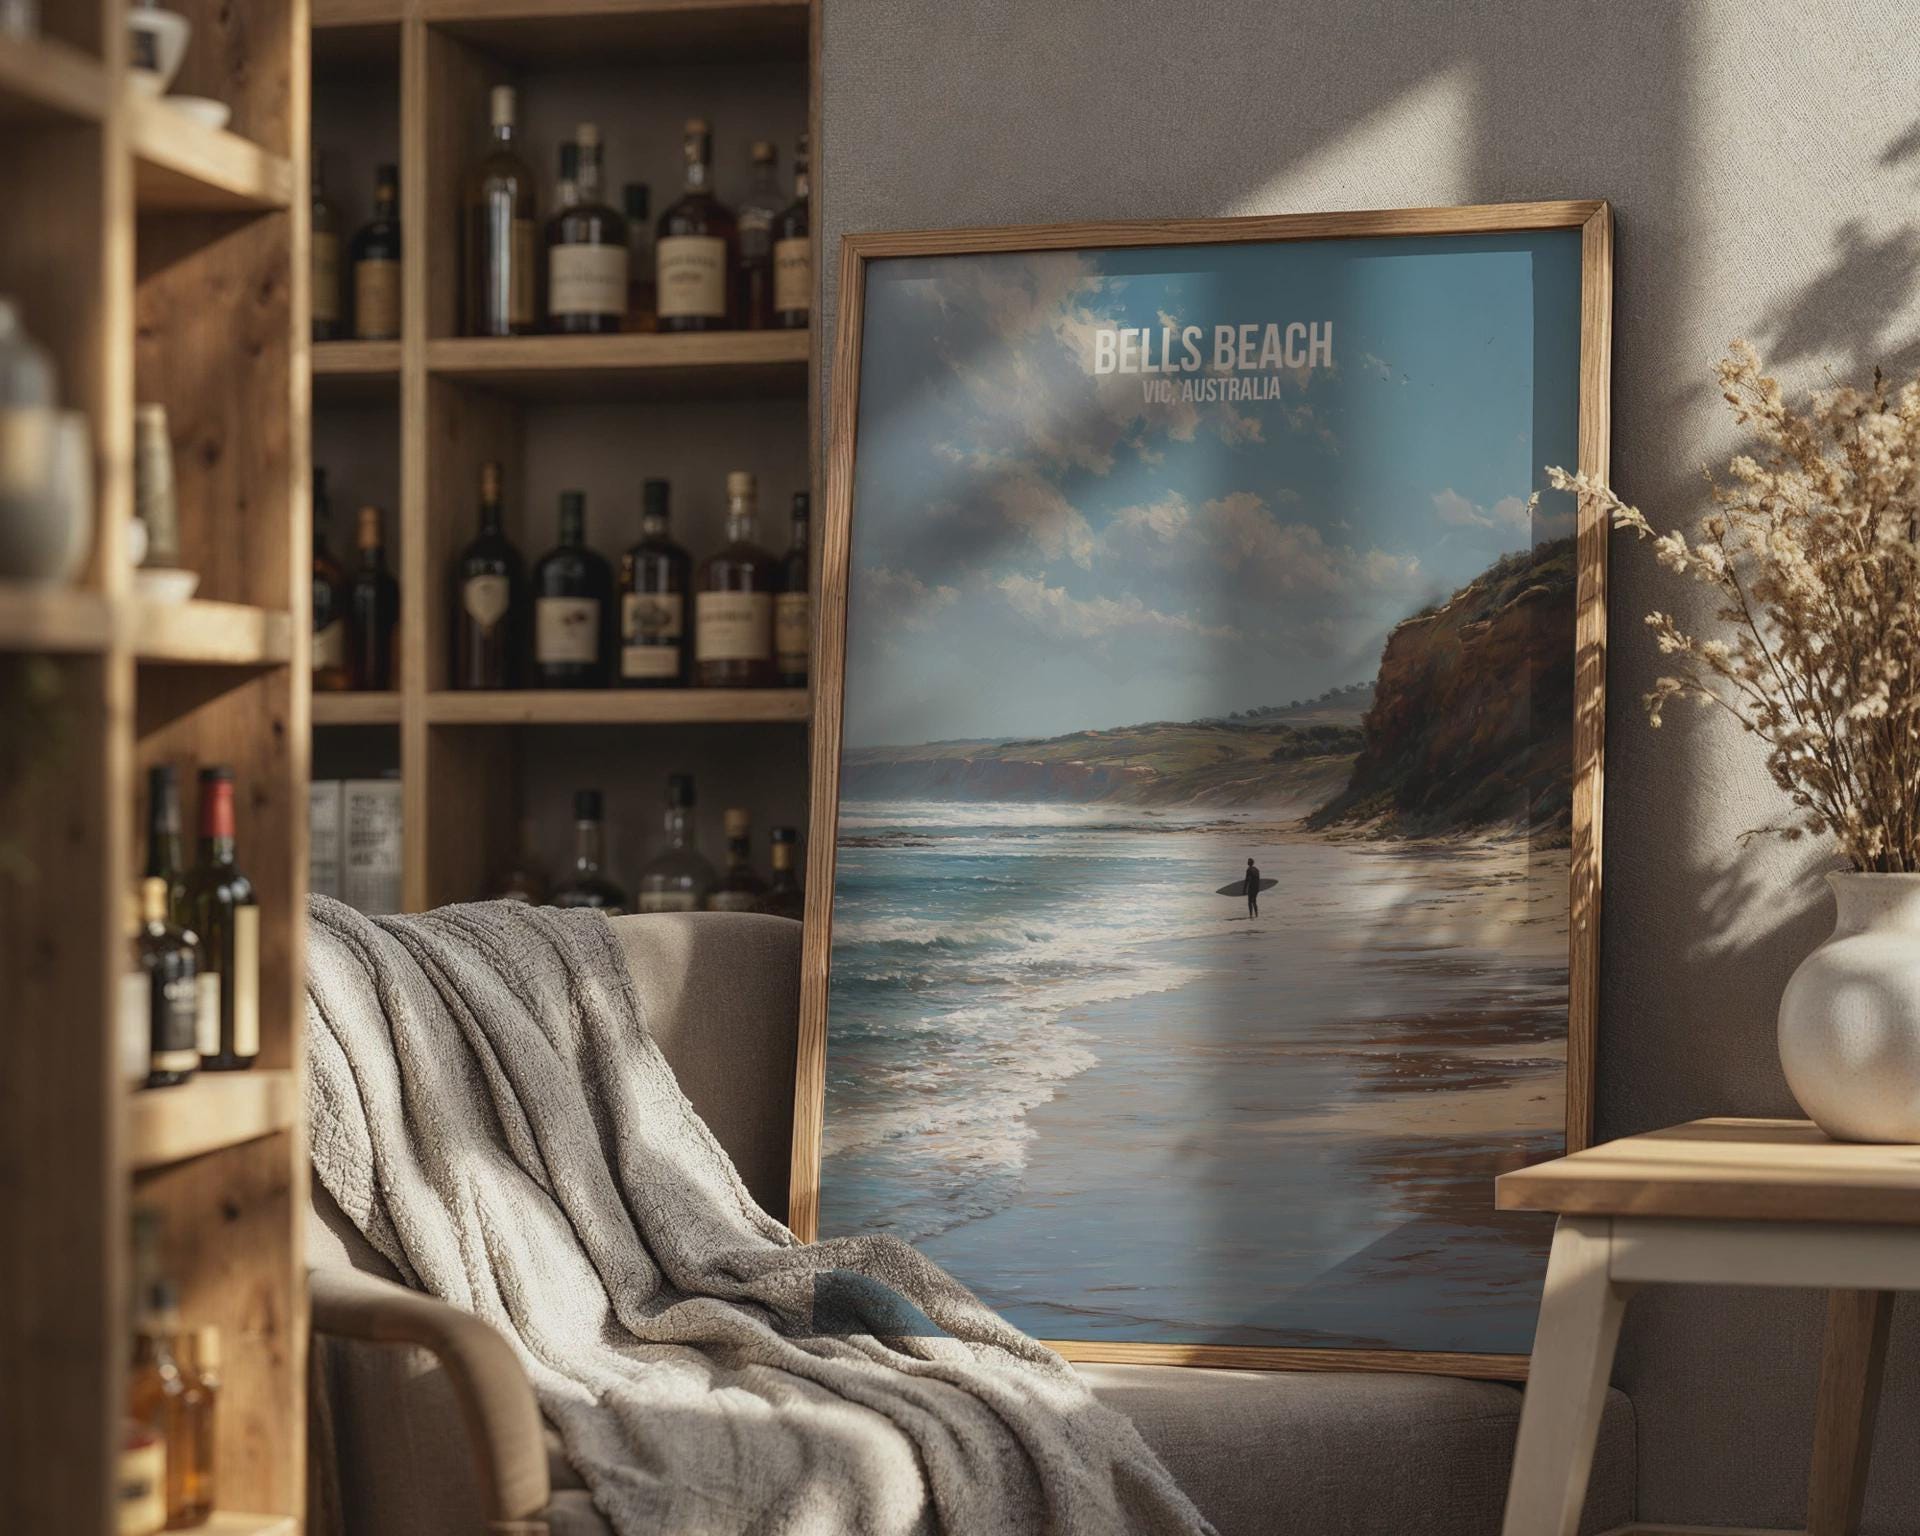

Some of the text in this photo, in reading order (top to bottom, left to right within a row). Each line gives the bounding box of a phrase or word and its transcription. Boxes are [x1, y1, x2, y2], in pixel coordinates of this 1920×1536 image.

[1095, 321, 1333, 374] BELLS BEACH
[1142, 376, 1281, 405] VIC, AUSTRALIA
